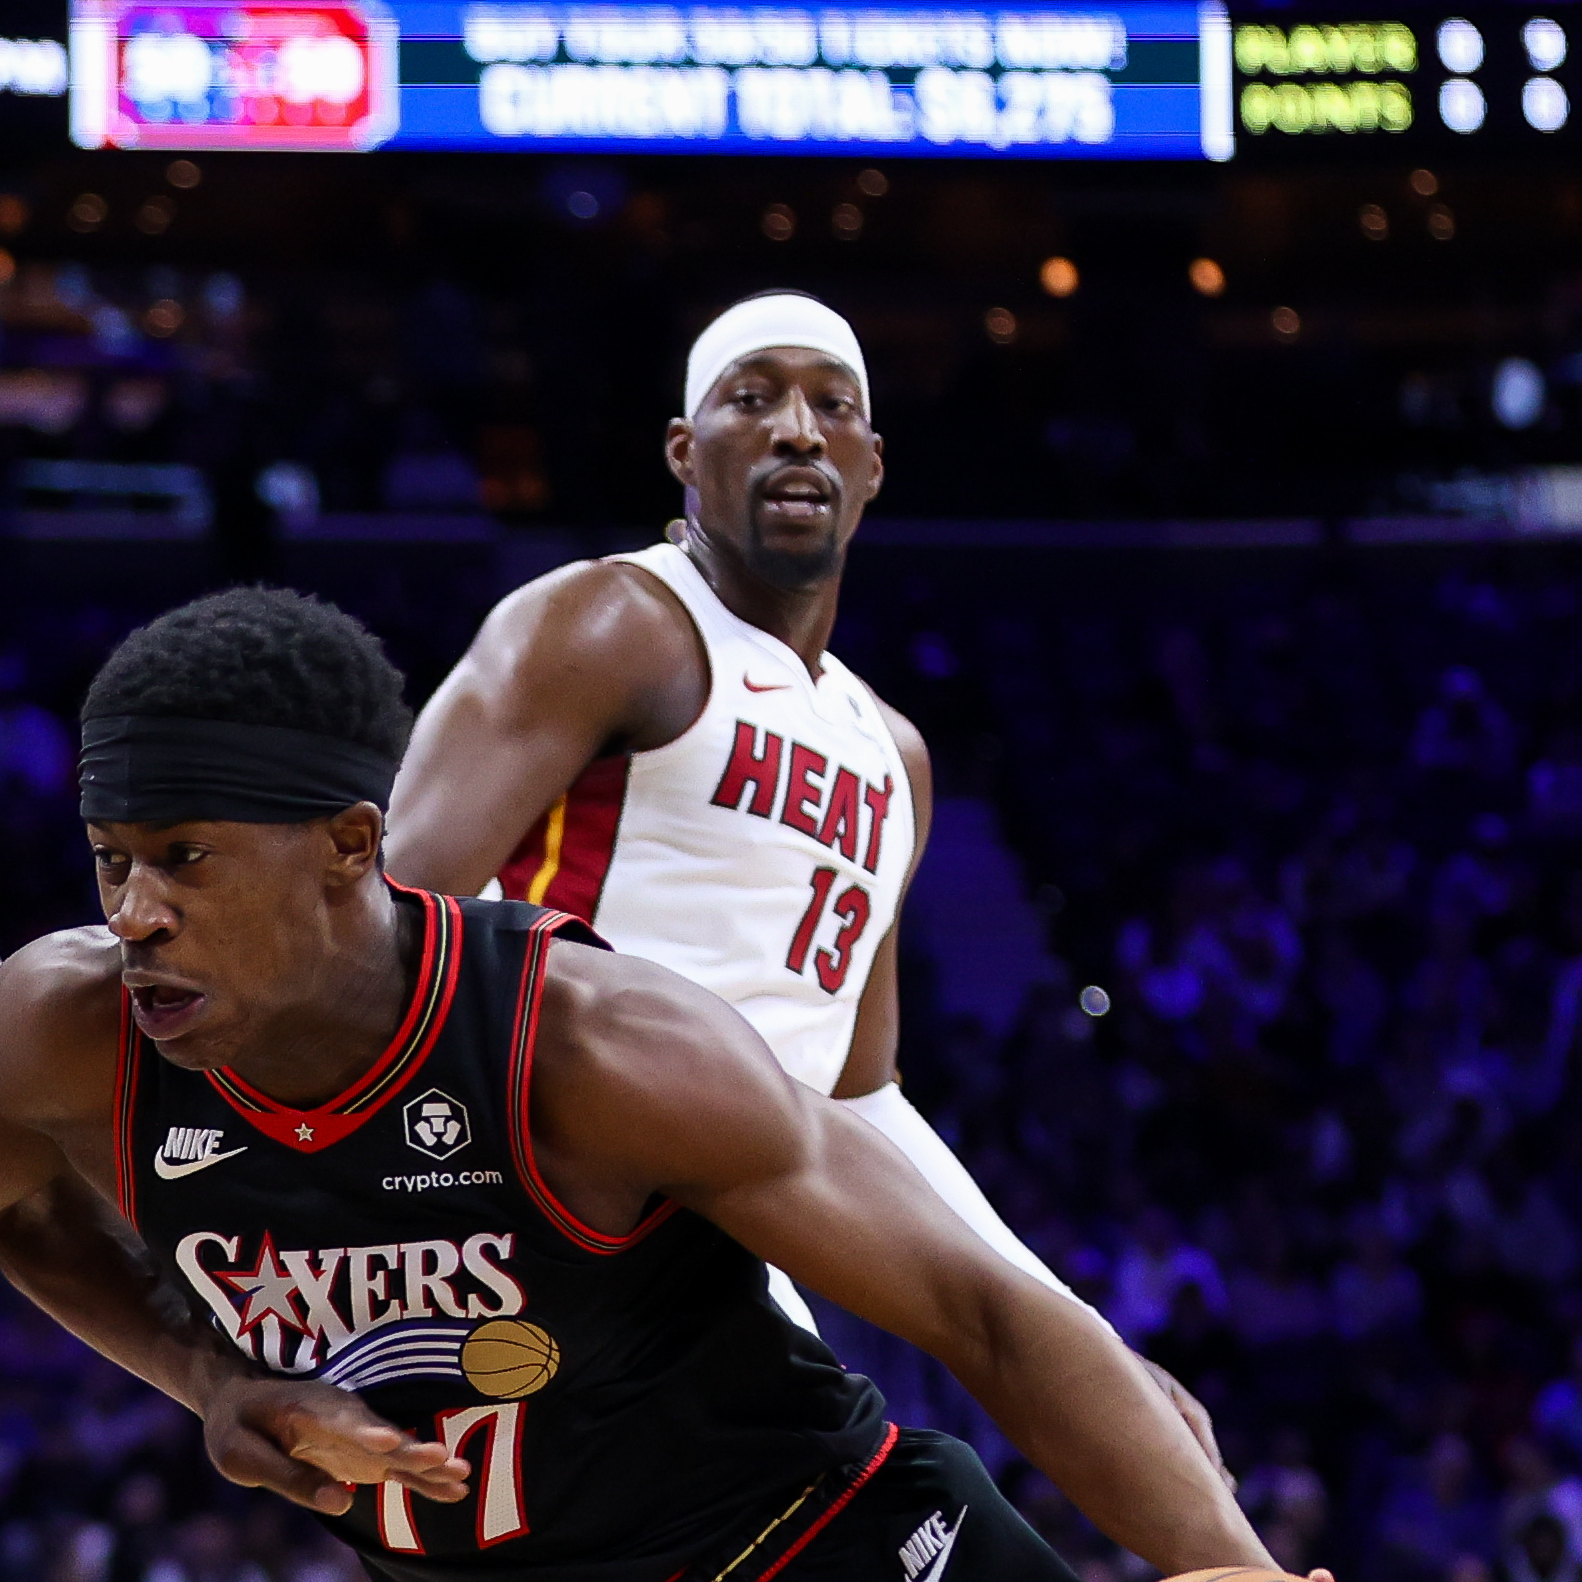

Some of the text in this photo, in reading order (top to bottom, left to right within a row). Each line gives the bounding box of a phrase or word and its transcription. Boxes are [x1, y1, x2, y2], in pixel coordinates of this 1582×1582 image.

[710, 720, 894, 875] HEAT
[785, 865, 871, 995] 13
[163, 1126, 225, 1161] NIKE
[382, 1168, 503, 1193] crypto.com
[897, 1509, 954, 1579] NIKE
